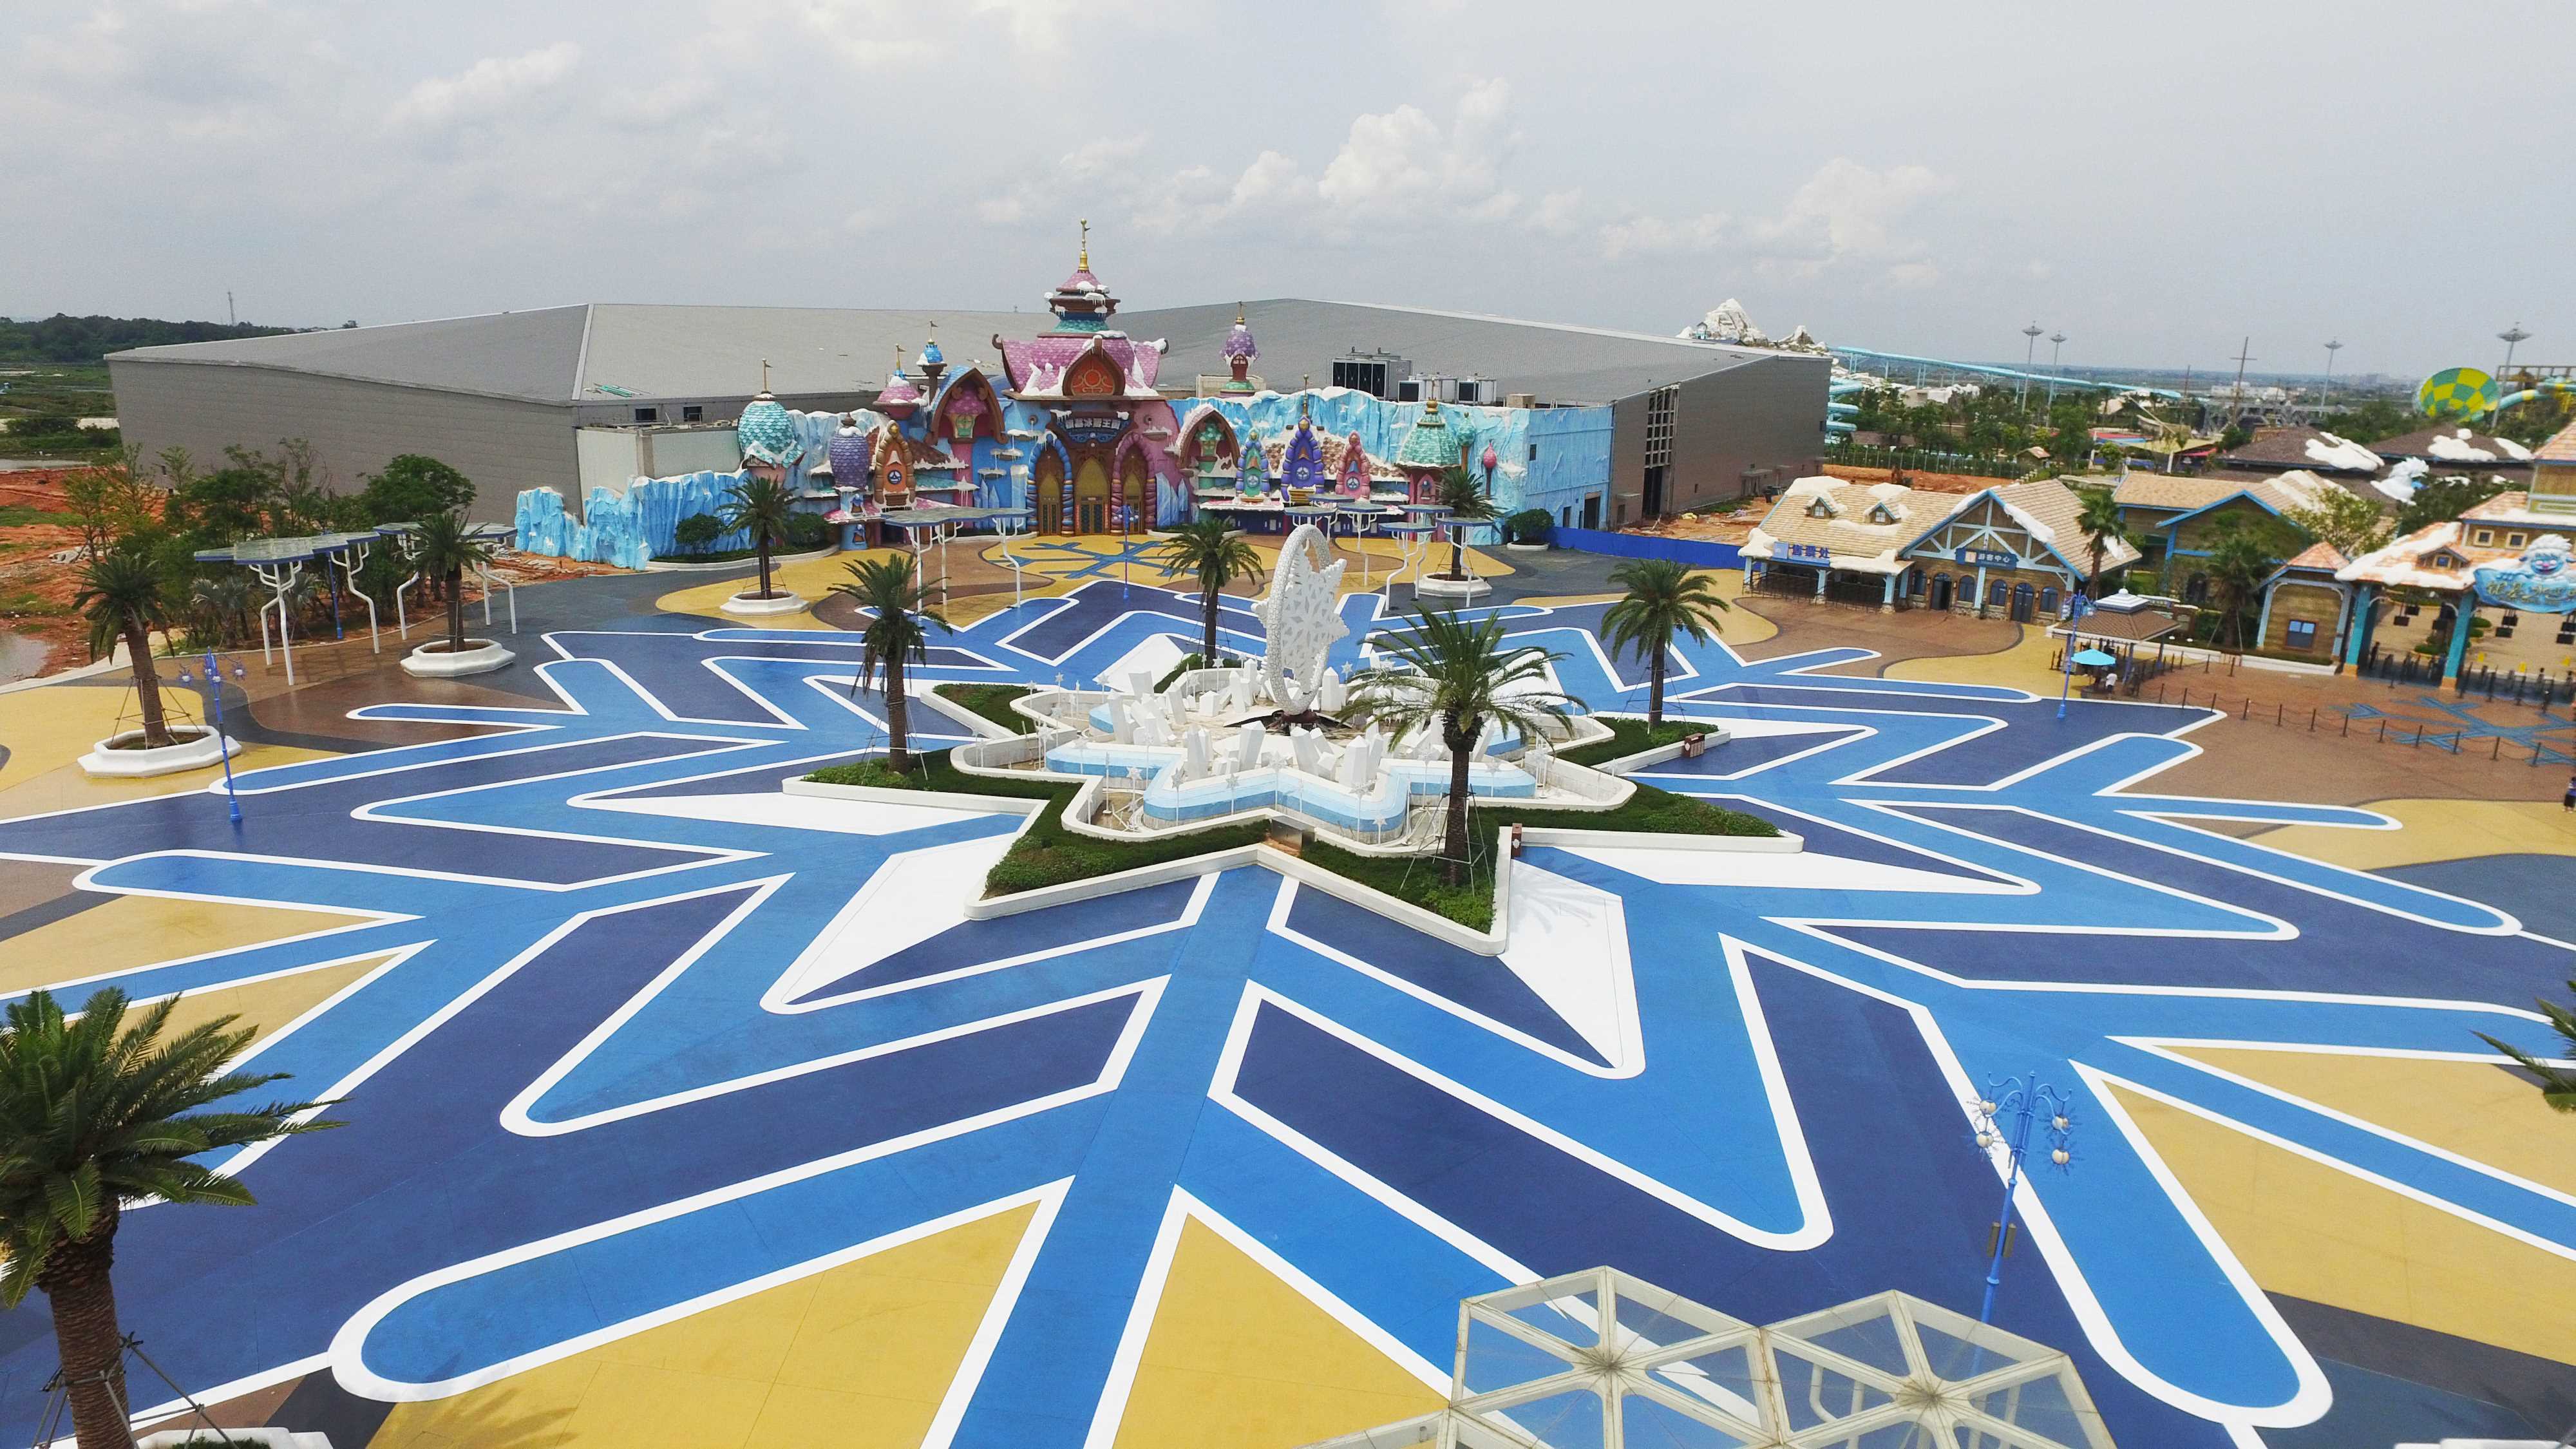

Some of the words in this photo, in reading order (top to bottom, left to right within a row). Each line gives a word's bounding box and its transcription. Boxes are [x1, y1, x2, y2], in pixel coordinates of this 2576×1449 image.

[1792, 545, 1830, 558] 售票处
[1978, 553, 2010, 563] 游客中心
